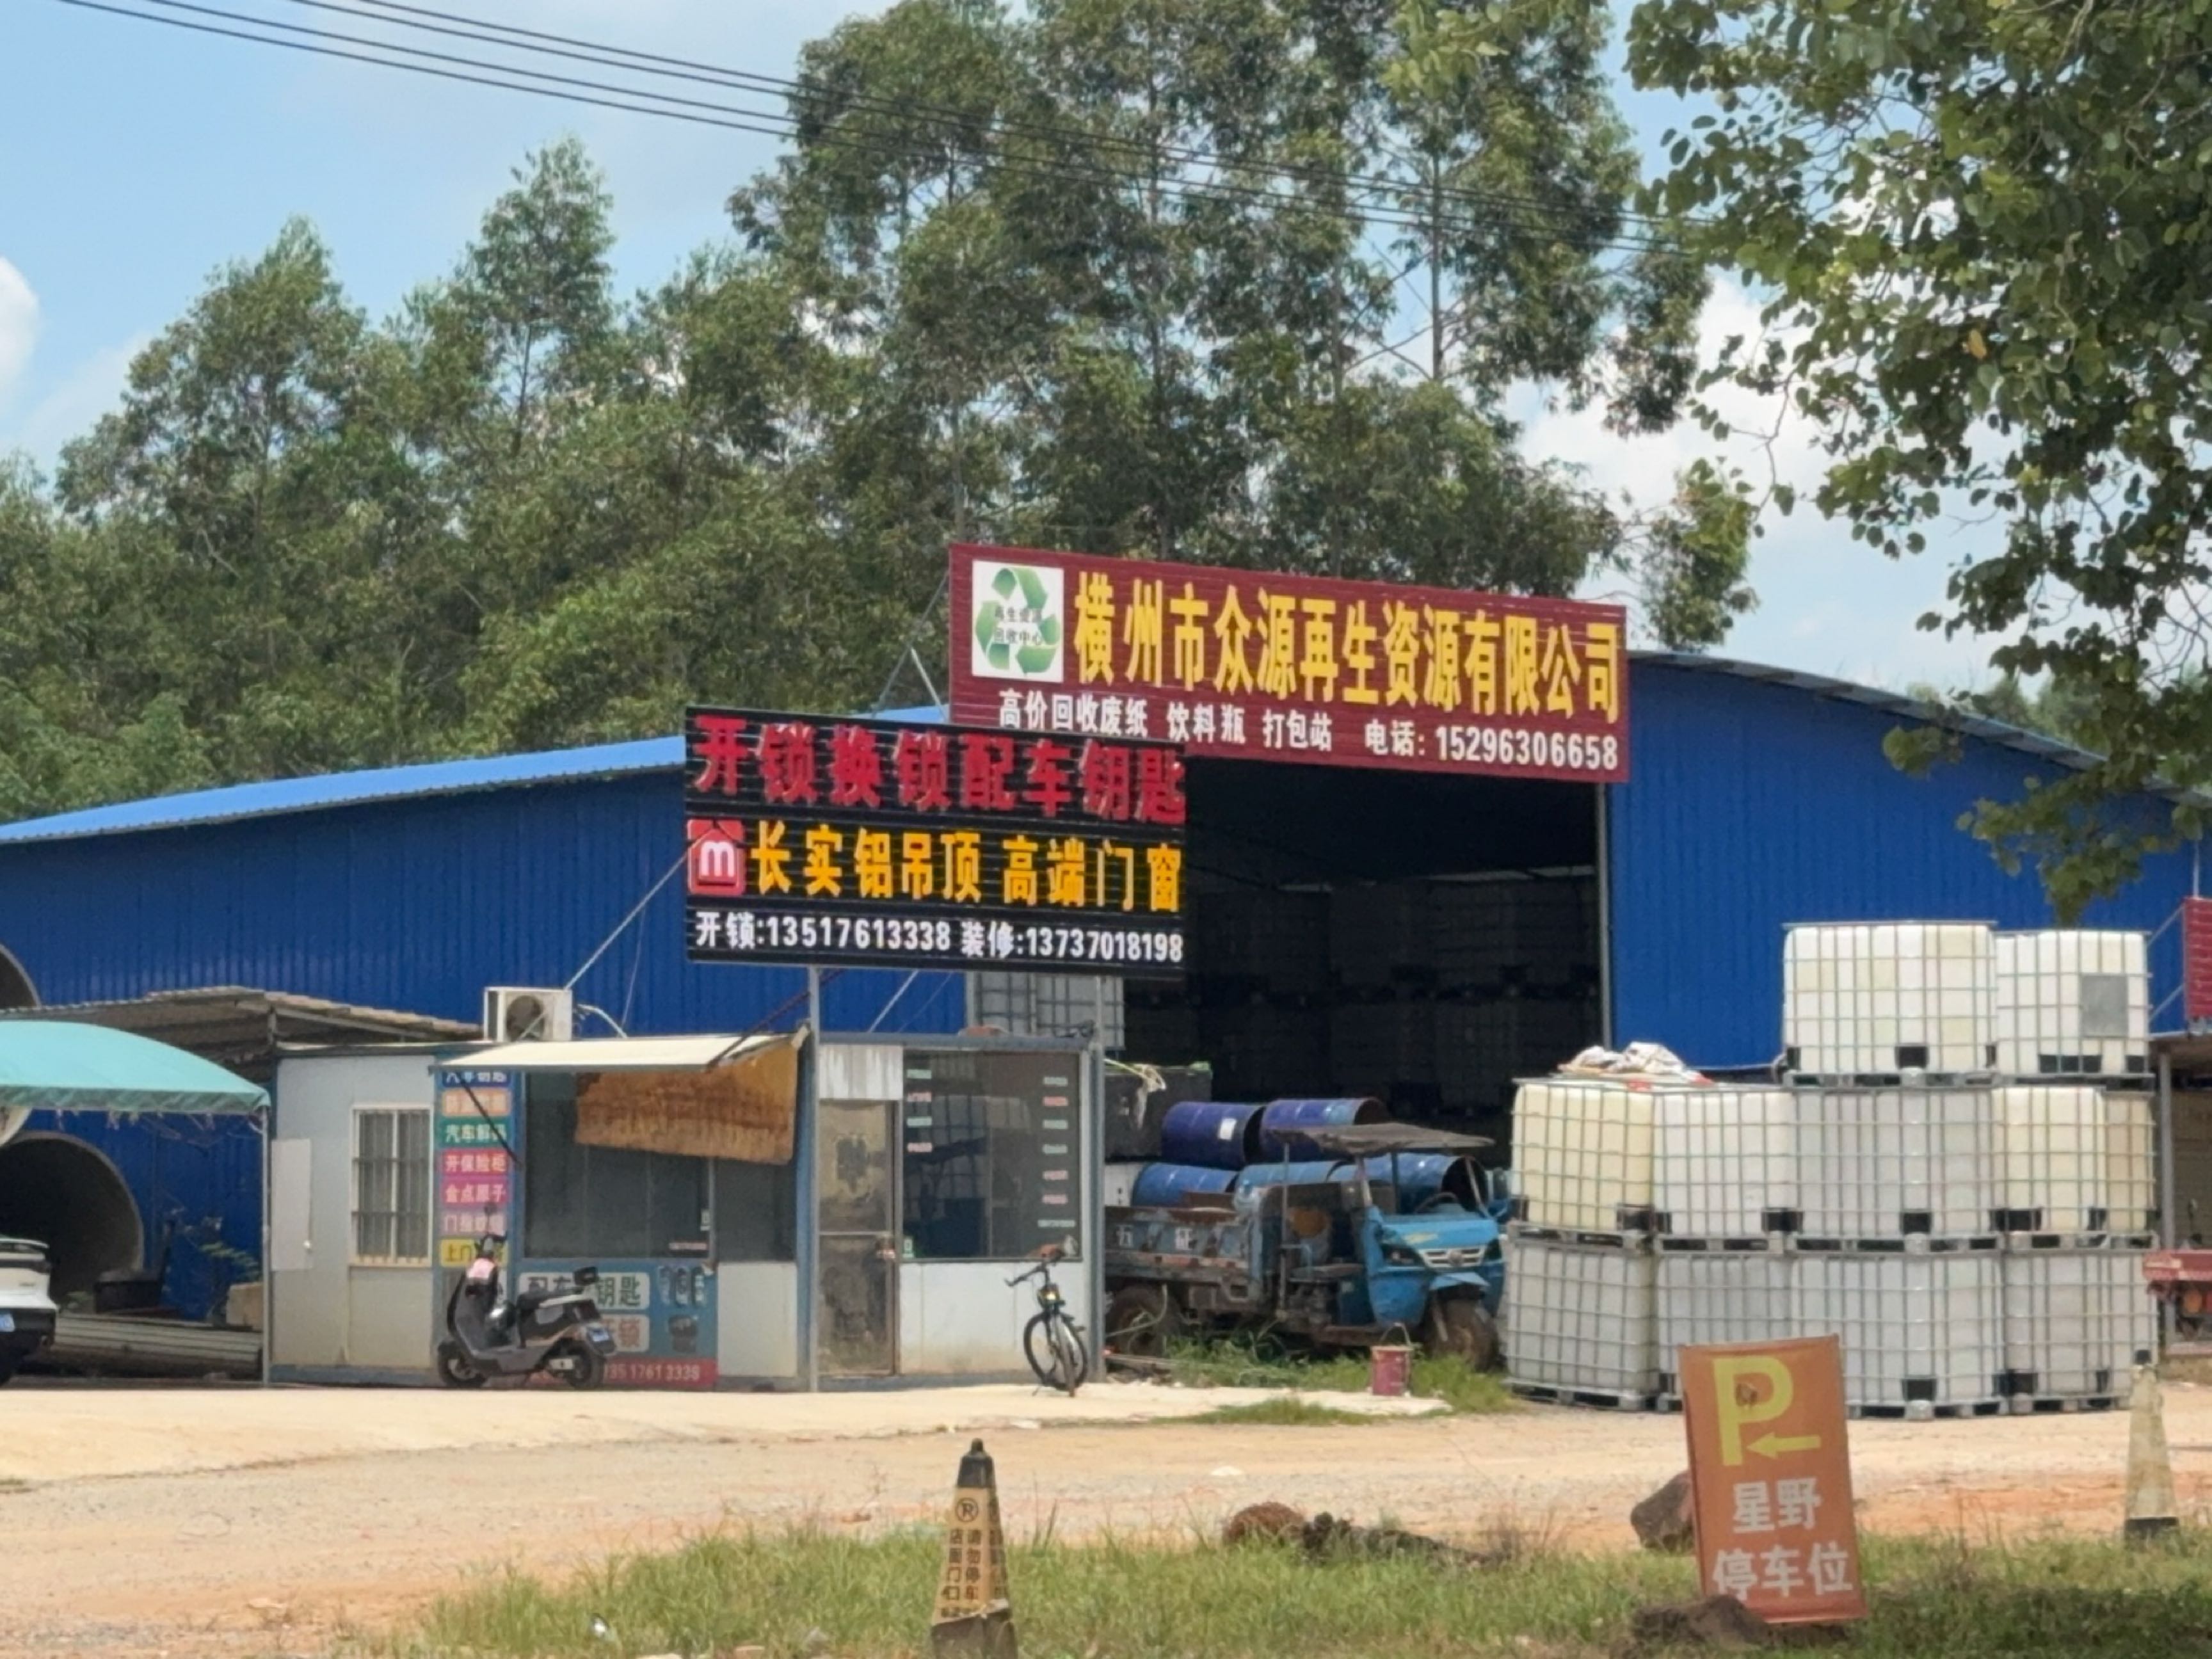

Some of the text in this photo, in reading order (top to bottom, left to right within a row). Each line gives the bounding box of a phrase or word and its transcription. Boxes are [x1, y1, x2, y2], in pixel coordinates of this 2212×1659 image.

[1074, 571, 1619, 724] 横州市众源再生资源有限公司
[998, 687, 1149, 739] 高价回收废纸
[1166, 701, 1246, 745] 饮料瓶
[1262, 708, 1333, 753] 打包站
[691, 714, 1186, 824] 开锁换锁配车钥匙
[751, 819, 1182, 913] 长实铝吊顶 高端门窗
[695, 911, 1184, 962] 开锁:13517613338 装修:13737018198
[1712, 1355, 1793, 1466] P
[1732, 1477, 1822, 1534] 星野
[1711, 1540, 1854, 1601] 停车位
